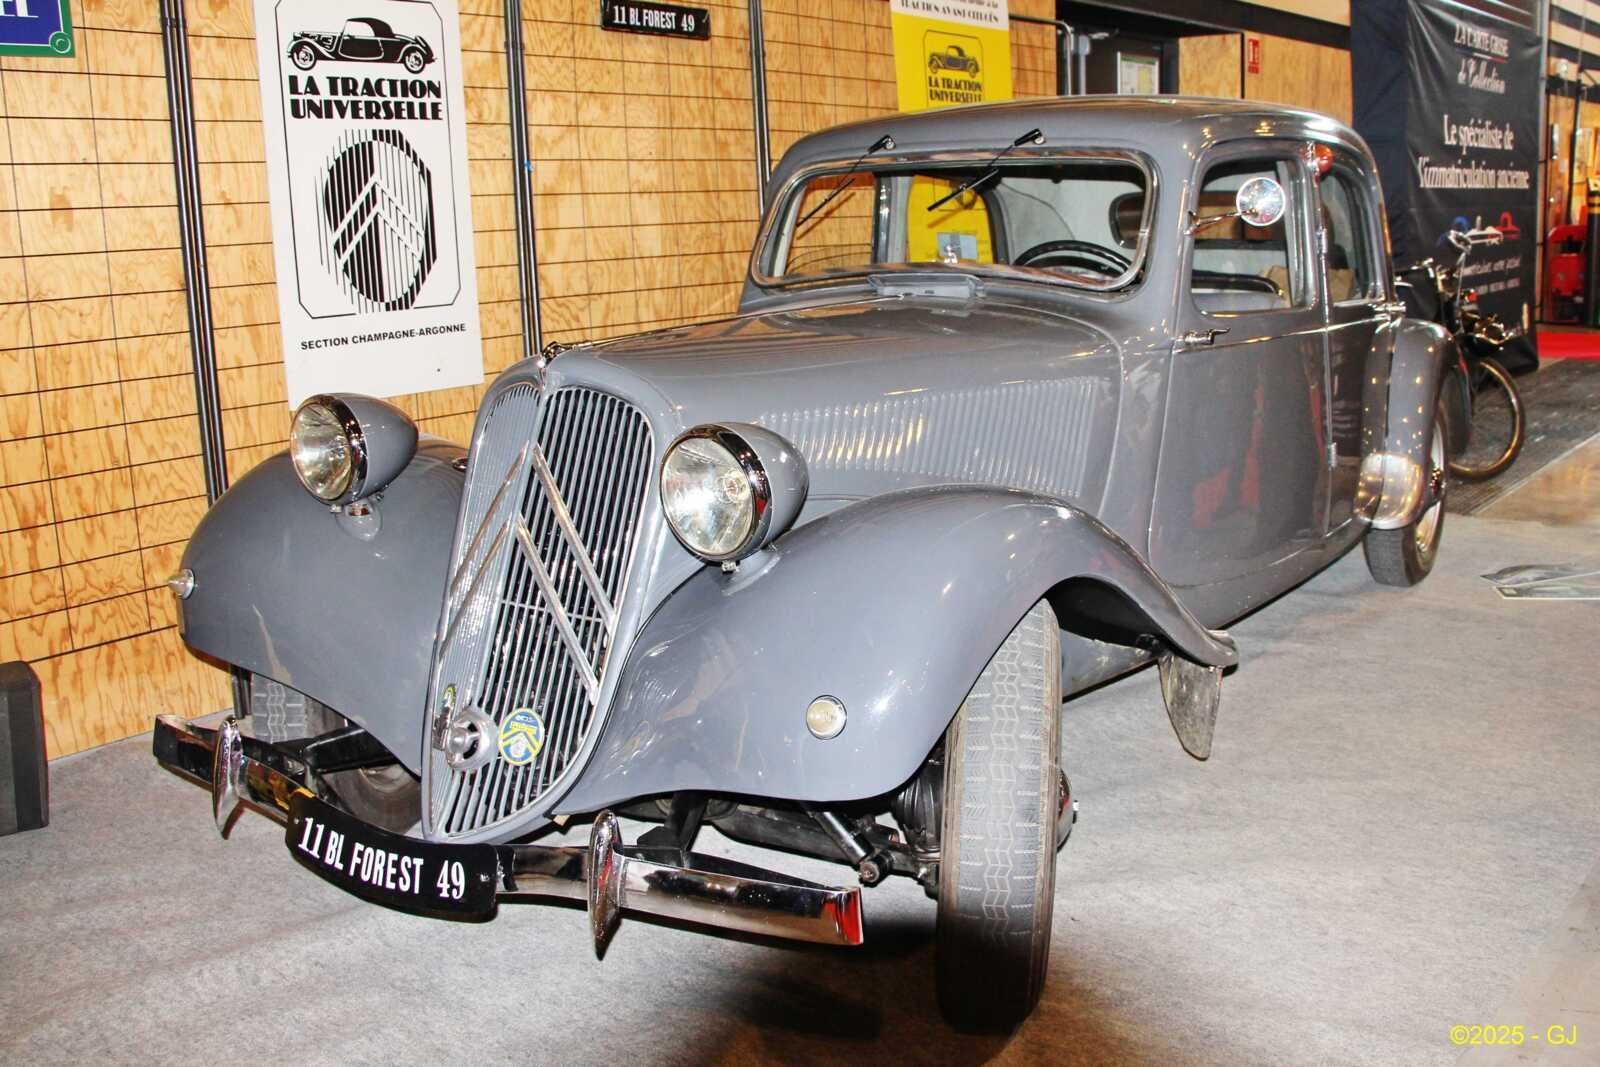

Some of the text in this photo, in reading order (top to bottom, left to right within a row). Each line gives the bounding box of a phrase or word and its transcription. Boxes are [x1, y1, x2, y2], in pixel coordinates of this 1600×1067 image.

[613, 5, 695, 32] 11 BL FOREST 49
[289, 75, 442, 98] LA TRACTION
[928, 76, 982, 92] LA TRACTION
[290, 98, 443, 120] UNIVERSELLE
[1504, 123, 1514, 150] de
[301, 323, 467, 350] SECTION CHAMPAGNE-ARGONNE
[298, 817, 466, 899] 11 BL FOREST 49
